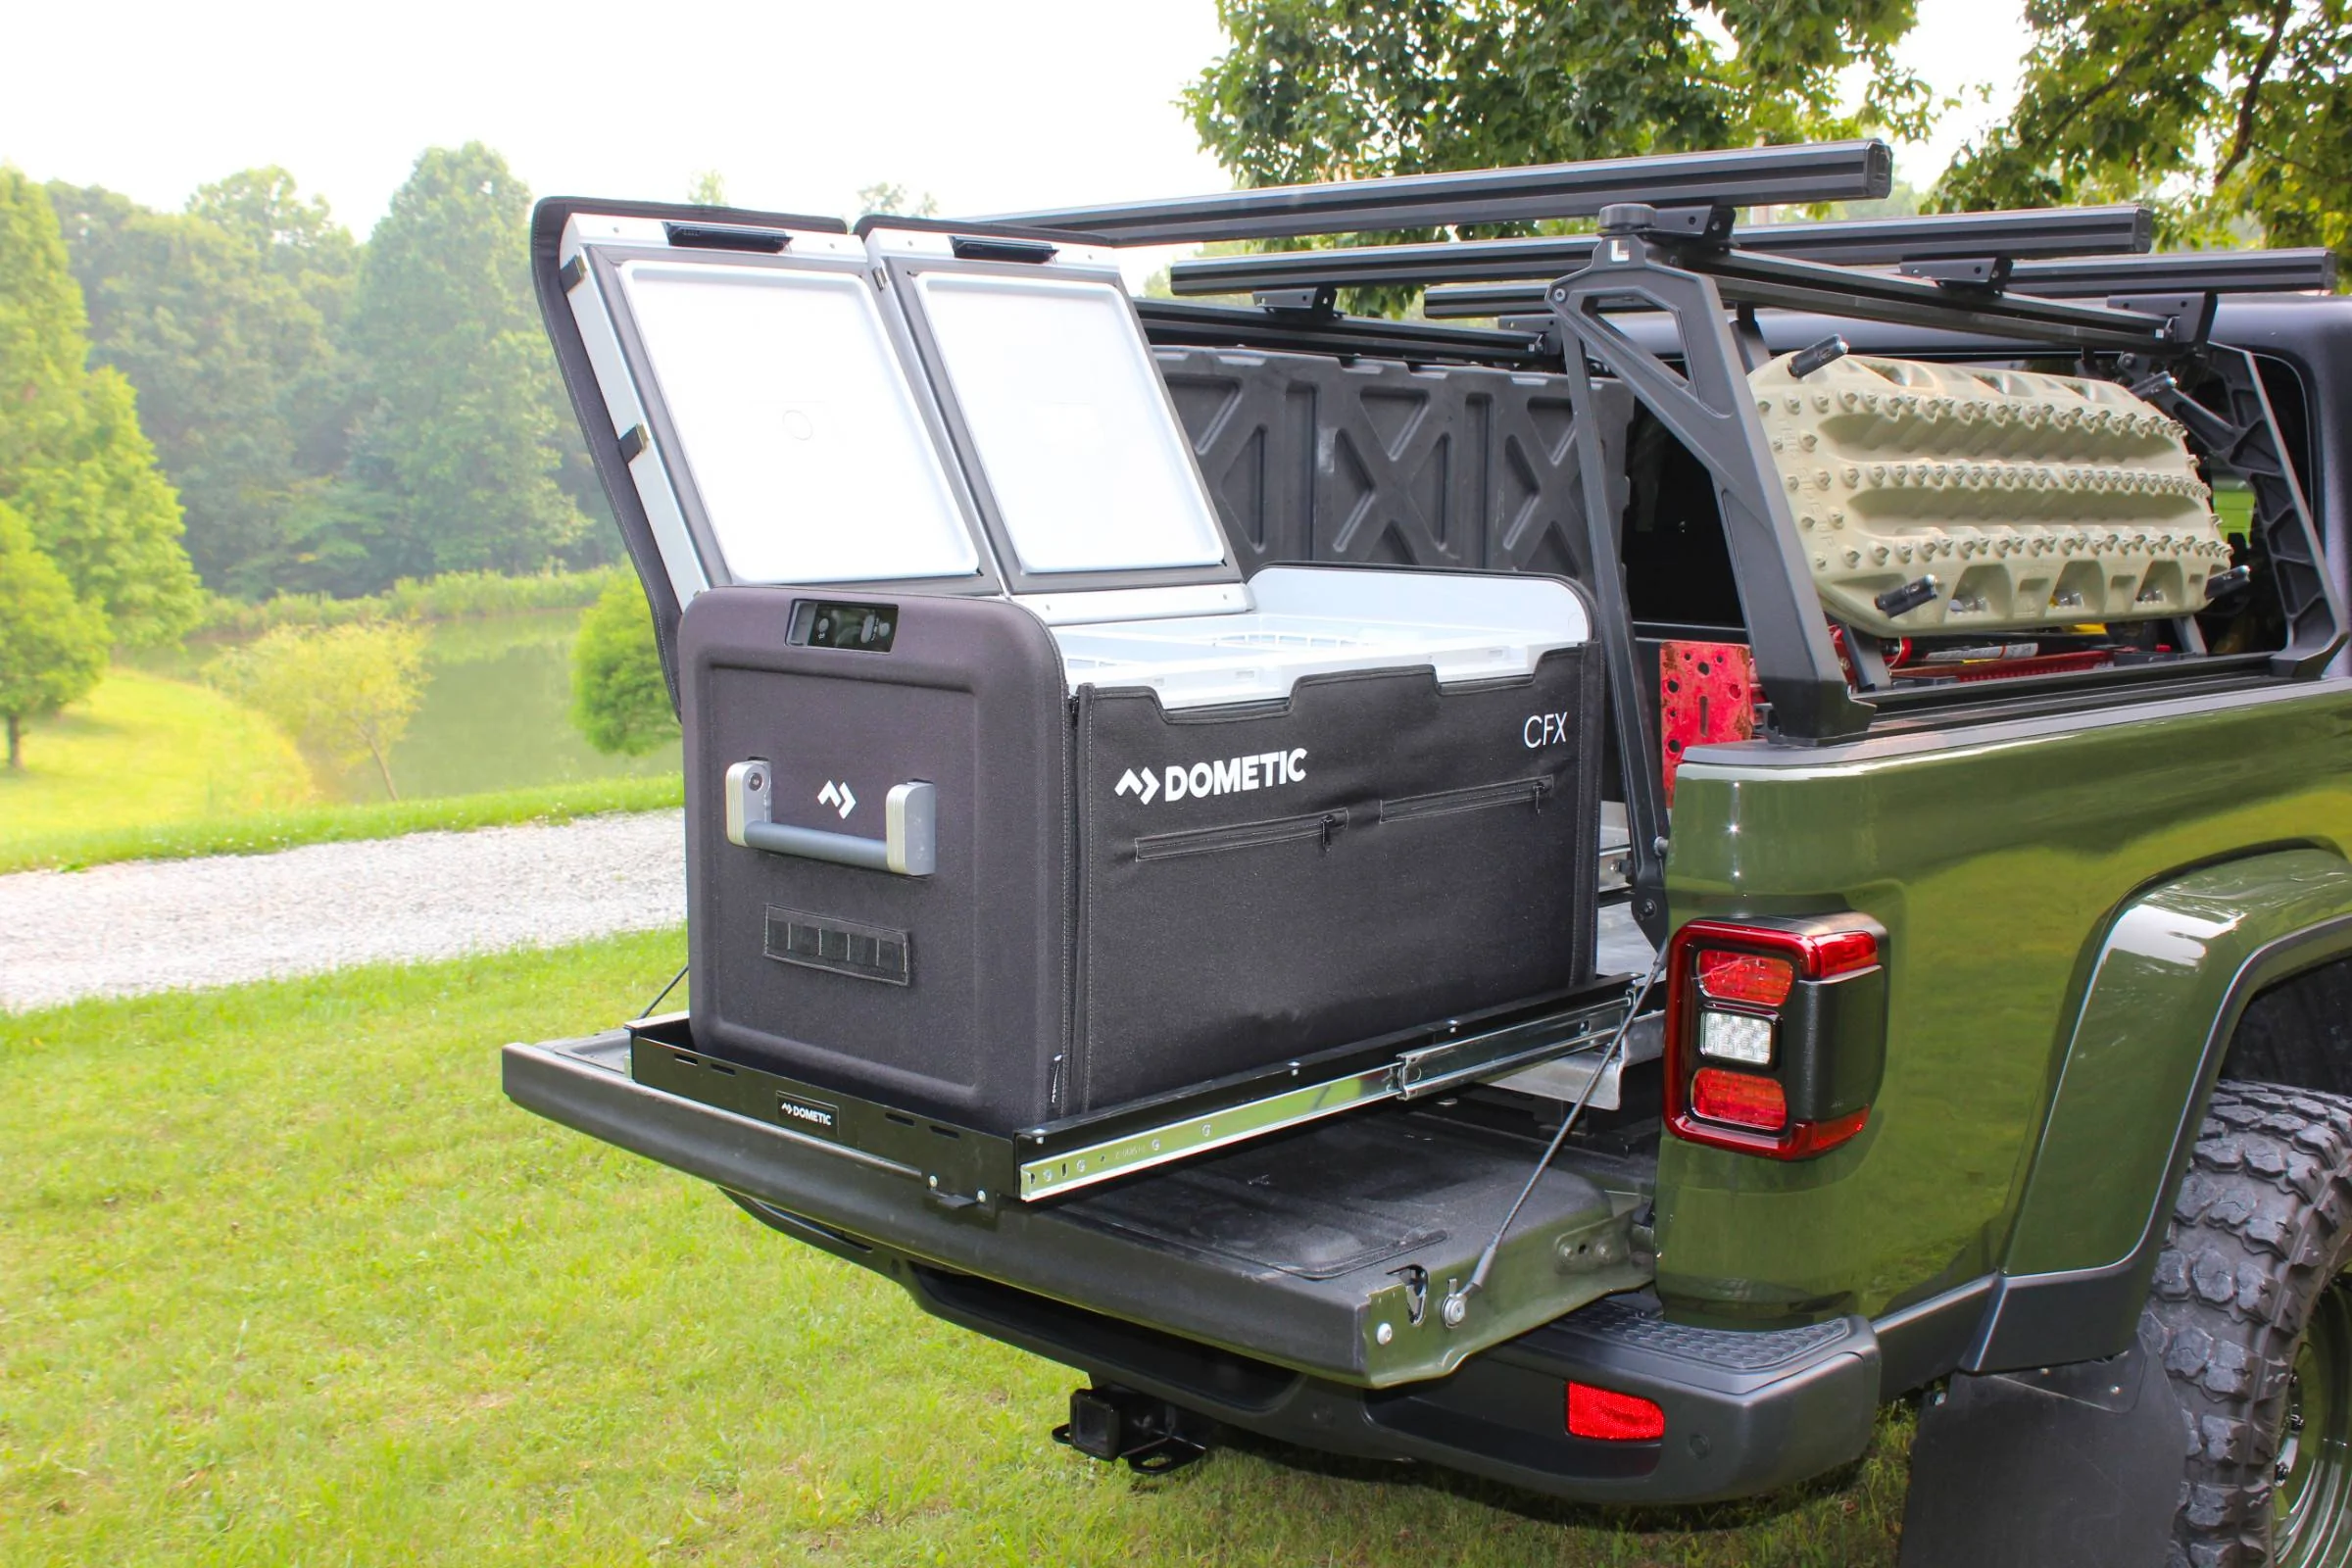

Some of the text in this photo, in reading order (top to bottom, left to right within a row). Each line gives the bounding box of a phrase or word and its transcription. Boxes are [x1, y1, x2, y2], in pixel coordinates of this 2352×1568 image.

[1524, 711, 1568, 749] CFX
[1164, 748, 1308, 803] DOMETIC
[793, 1105, 832, 1126] DOMETIC
